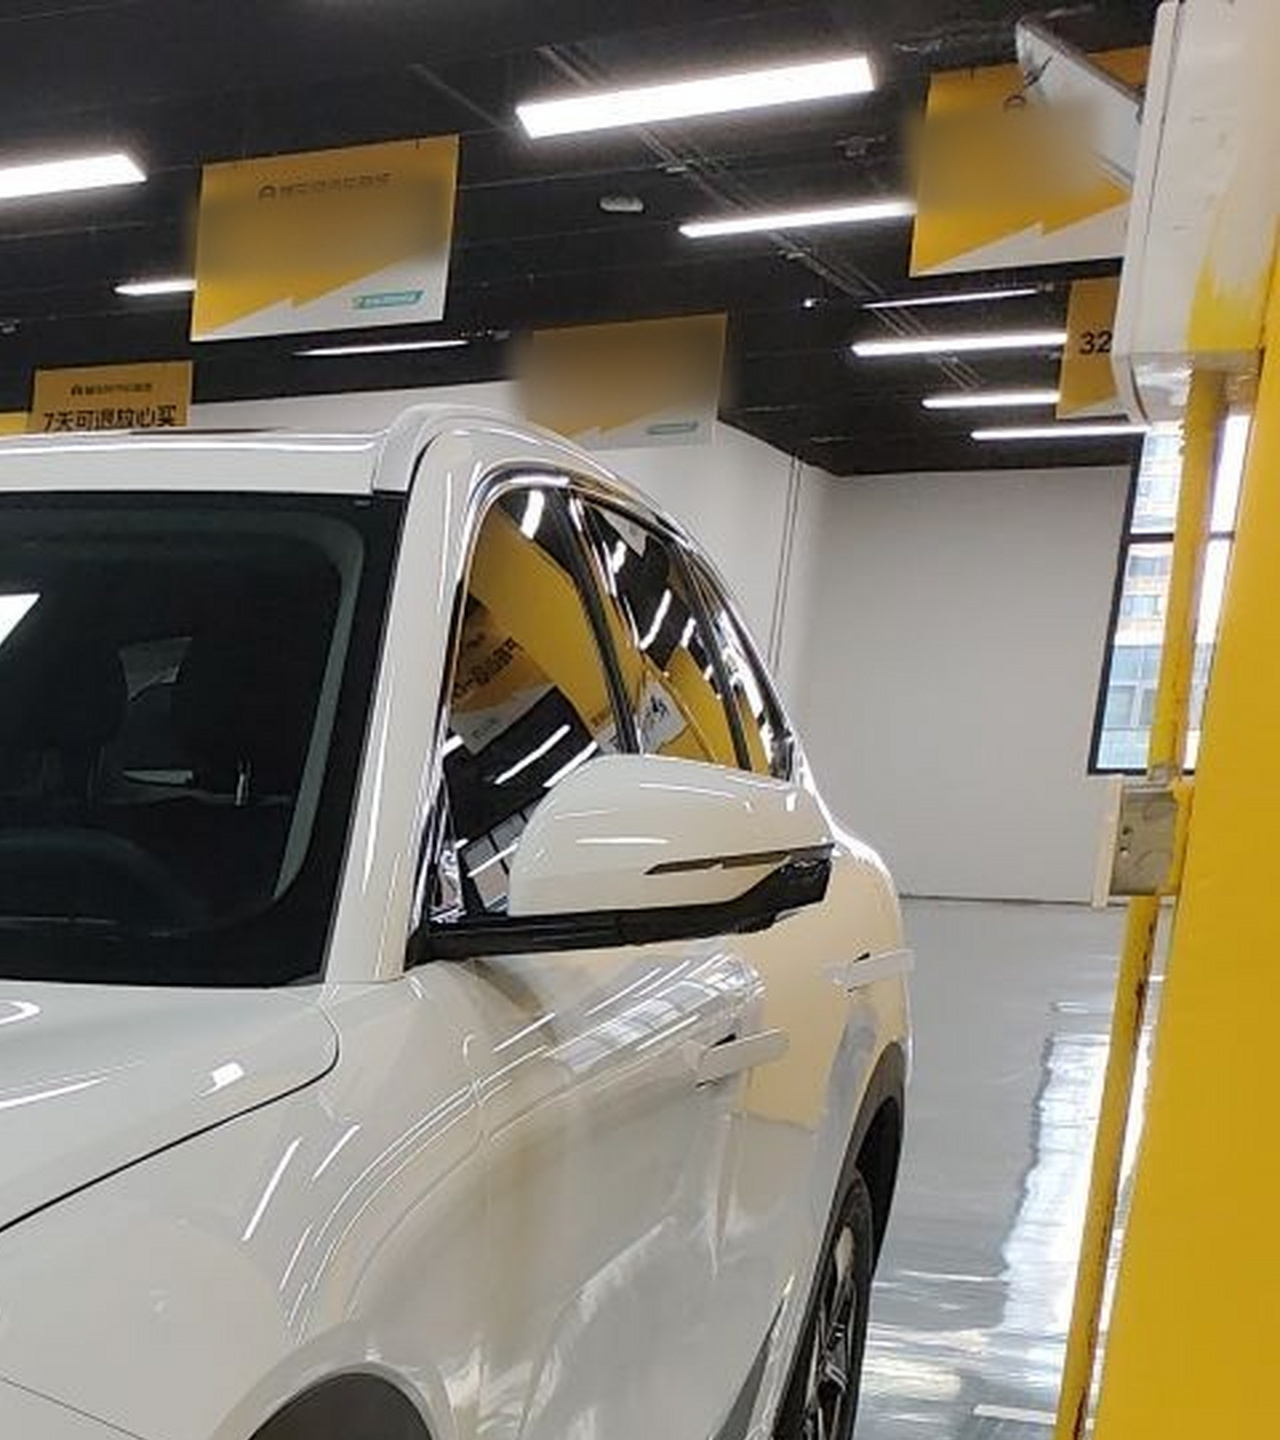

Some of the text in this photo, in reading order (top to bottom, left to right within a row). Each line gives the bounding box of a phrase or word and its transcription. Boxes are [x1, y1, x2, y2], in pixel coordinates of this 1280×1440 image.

[1079, 330, 1113, 355] 32
[42, 403, 178, 432] 7天可退放心买
